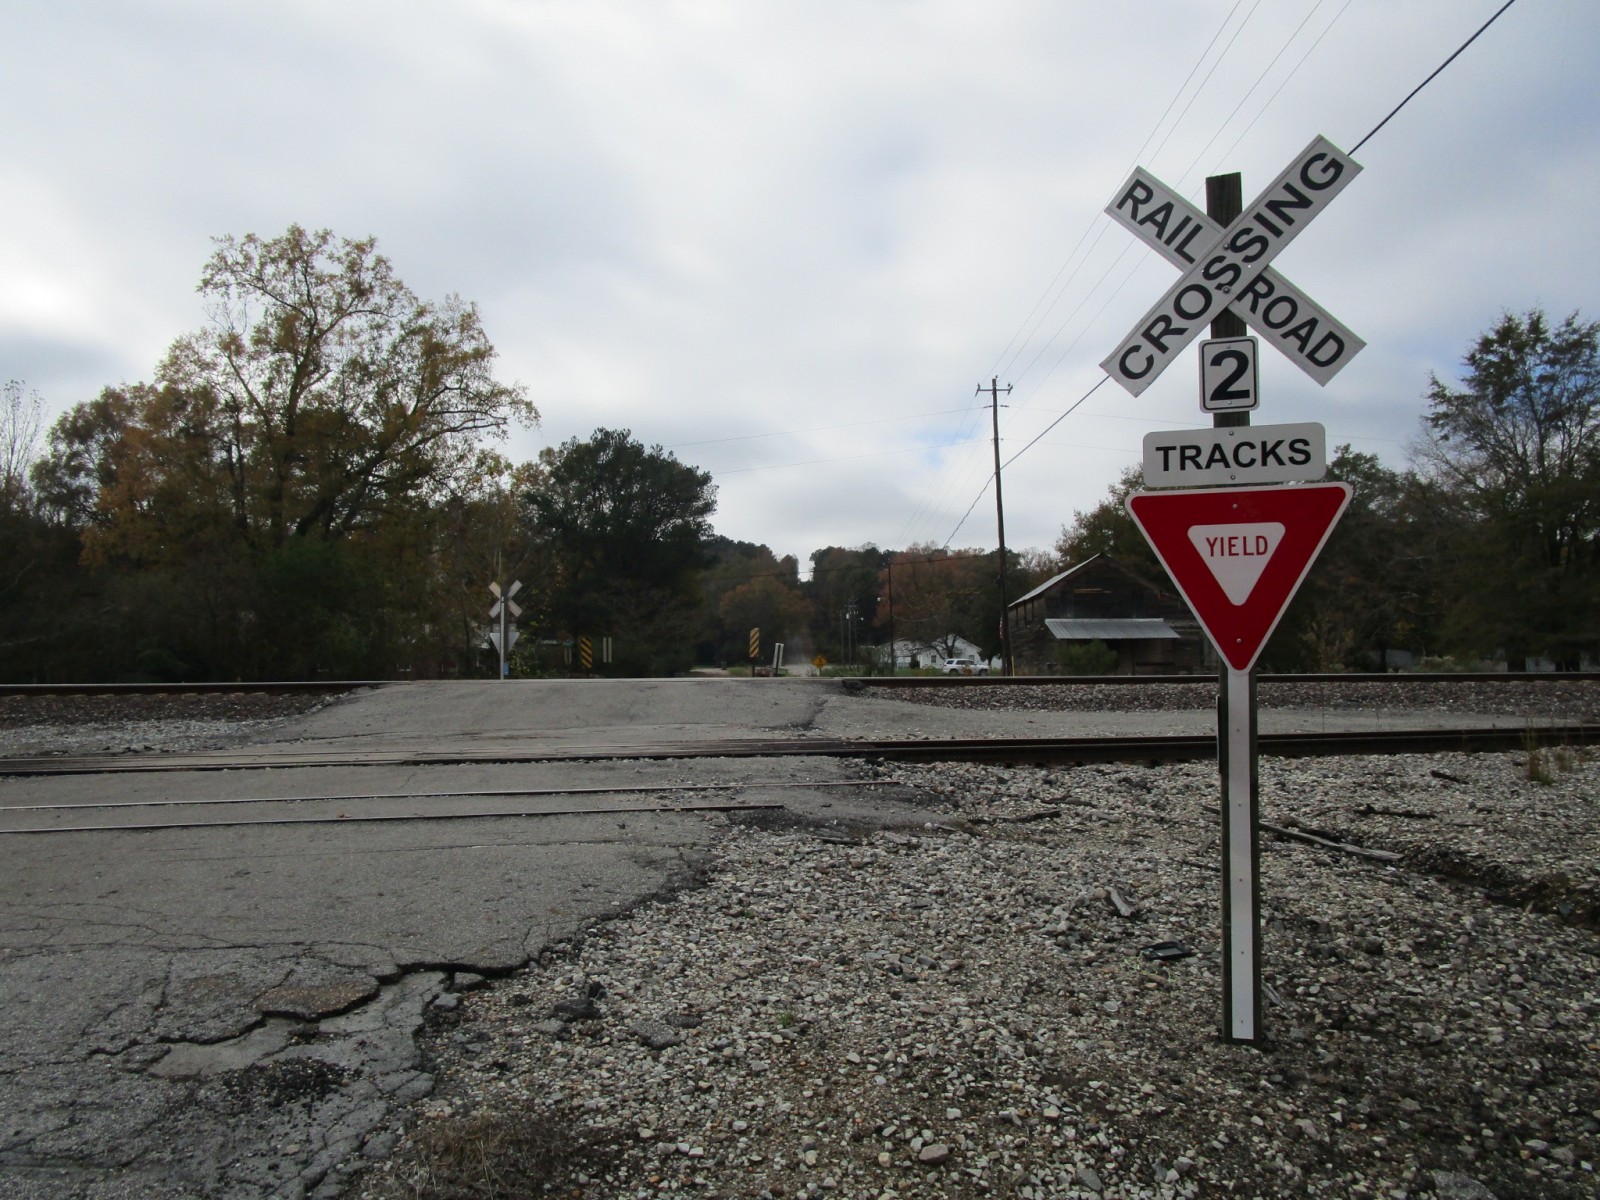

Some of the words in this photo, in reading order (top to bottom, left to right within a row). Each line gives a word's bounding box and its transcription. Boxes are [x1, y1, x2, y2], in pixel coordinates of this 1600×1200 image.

[1116, 178, 1203, 265] RAIL
[1236, 273, 1345, 368] ROAD
[1118, 152, 1344, 380] CROSSING
[1210, 350, 1250, 401] 2
[1155, 438, 1311, 472] TRACKS
[1205, 536, 1268, 557] YIELD
